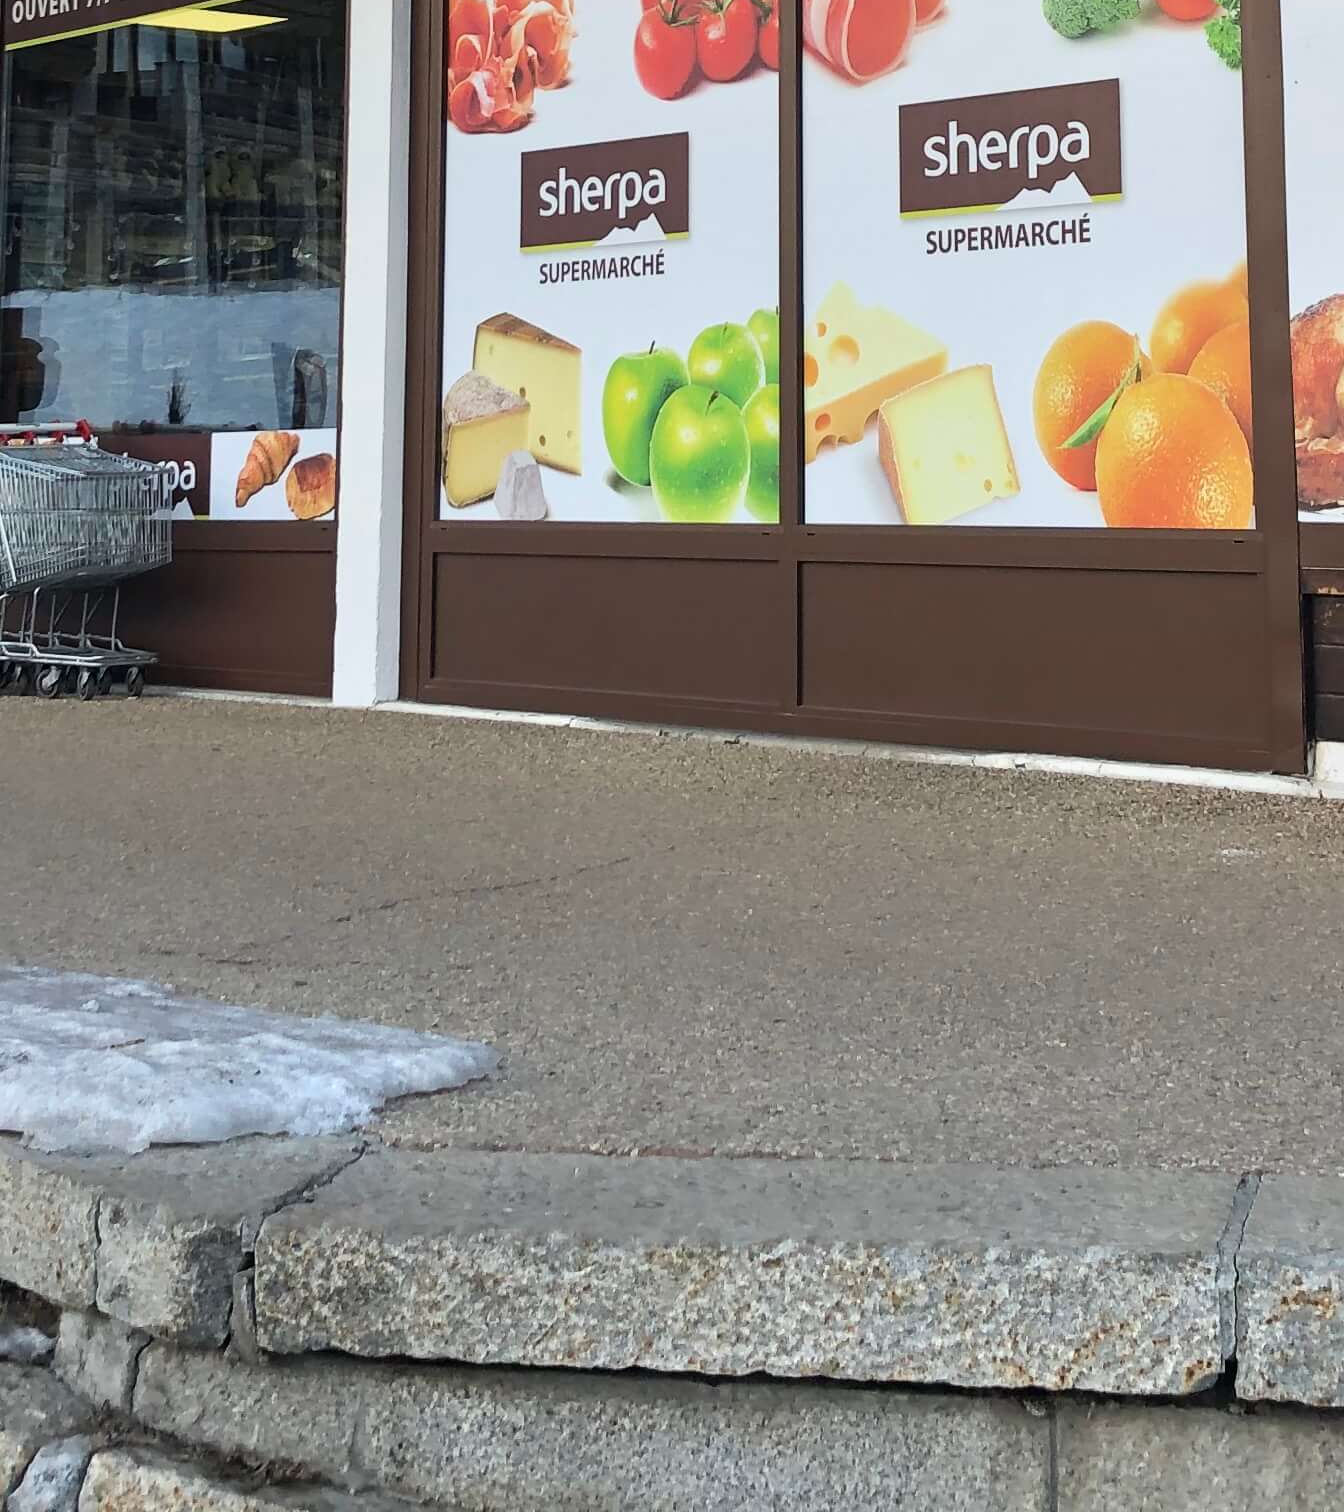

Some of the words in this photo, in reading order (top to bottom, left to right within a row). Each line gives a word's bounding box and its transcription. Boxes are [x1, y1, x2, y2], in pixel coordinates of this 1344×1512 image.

[923, 120, 1090, 179] sherpa
[539, 167, 666, 219] sherpa
[926, 213, 1091, 255] SUPERMARCHÉ
[539, 249, 665, 284] SUPERMARCHÉ
